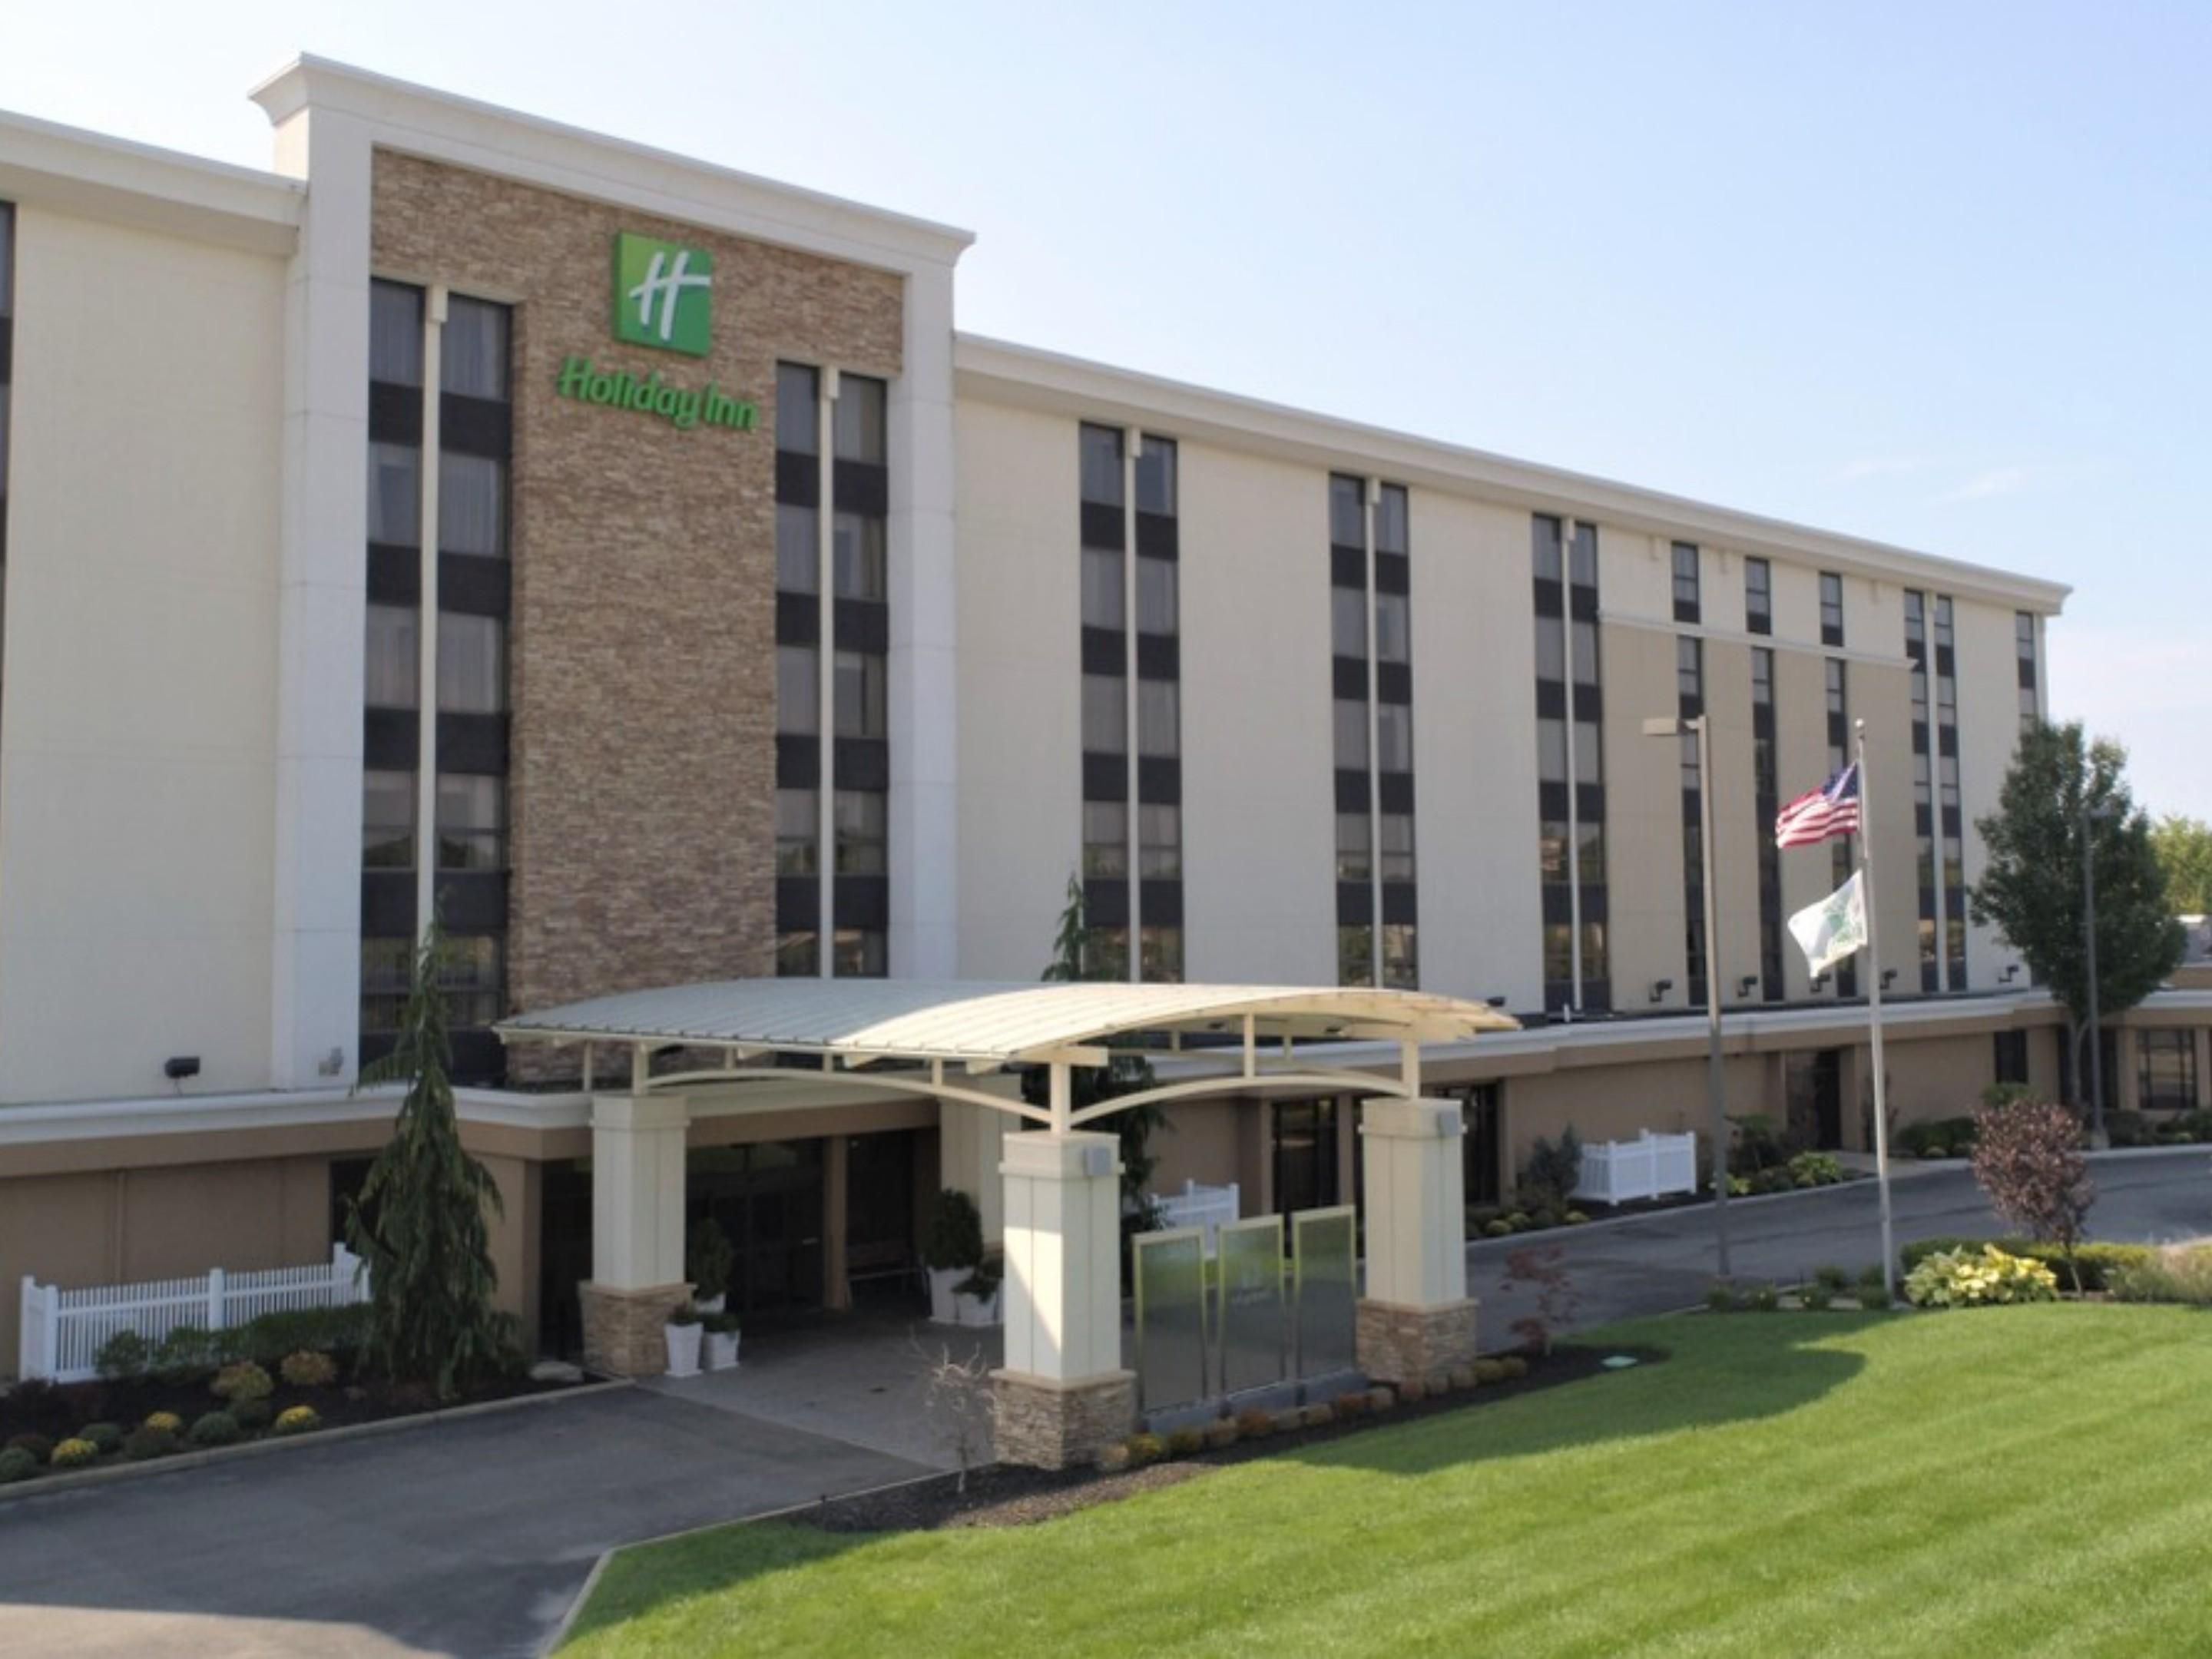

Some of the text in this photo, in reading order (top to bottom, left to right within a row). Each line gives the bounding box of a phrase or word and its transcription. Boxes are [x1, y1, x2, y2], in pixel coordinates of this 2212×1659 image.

[628, 250, 711, 340] H
[558, 355, 760, 432] Holiday Inn
